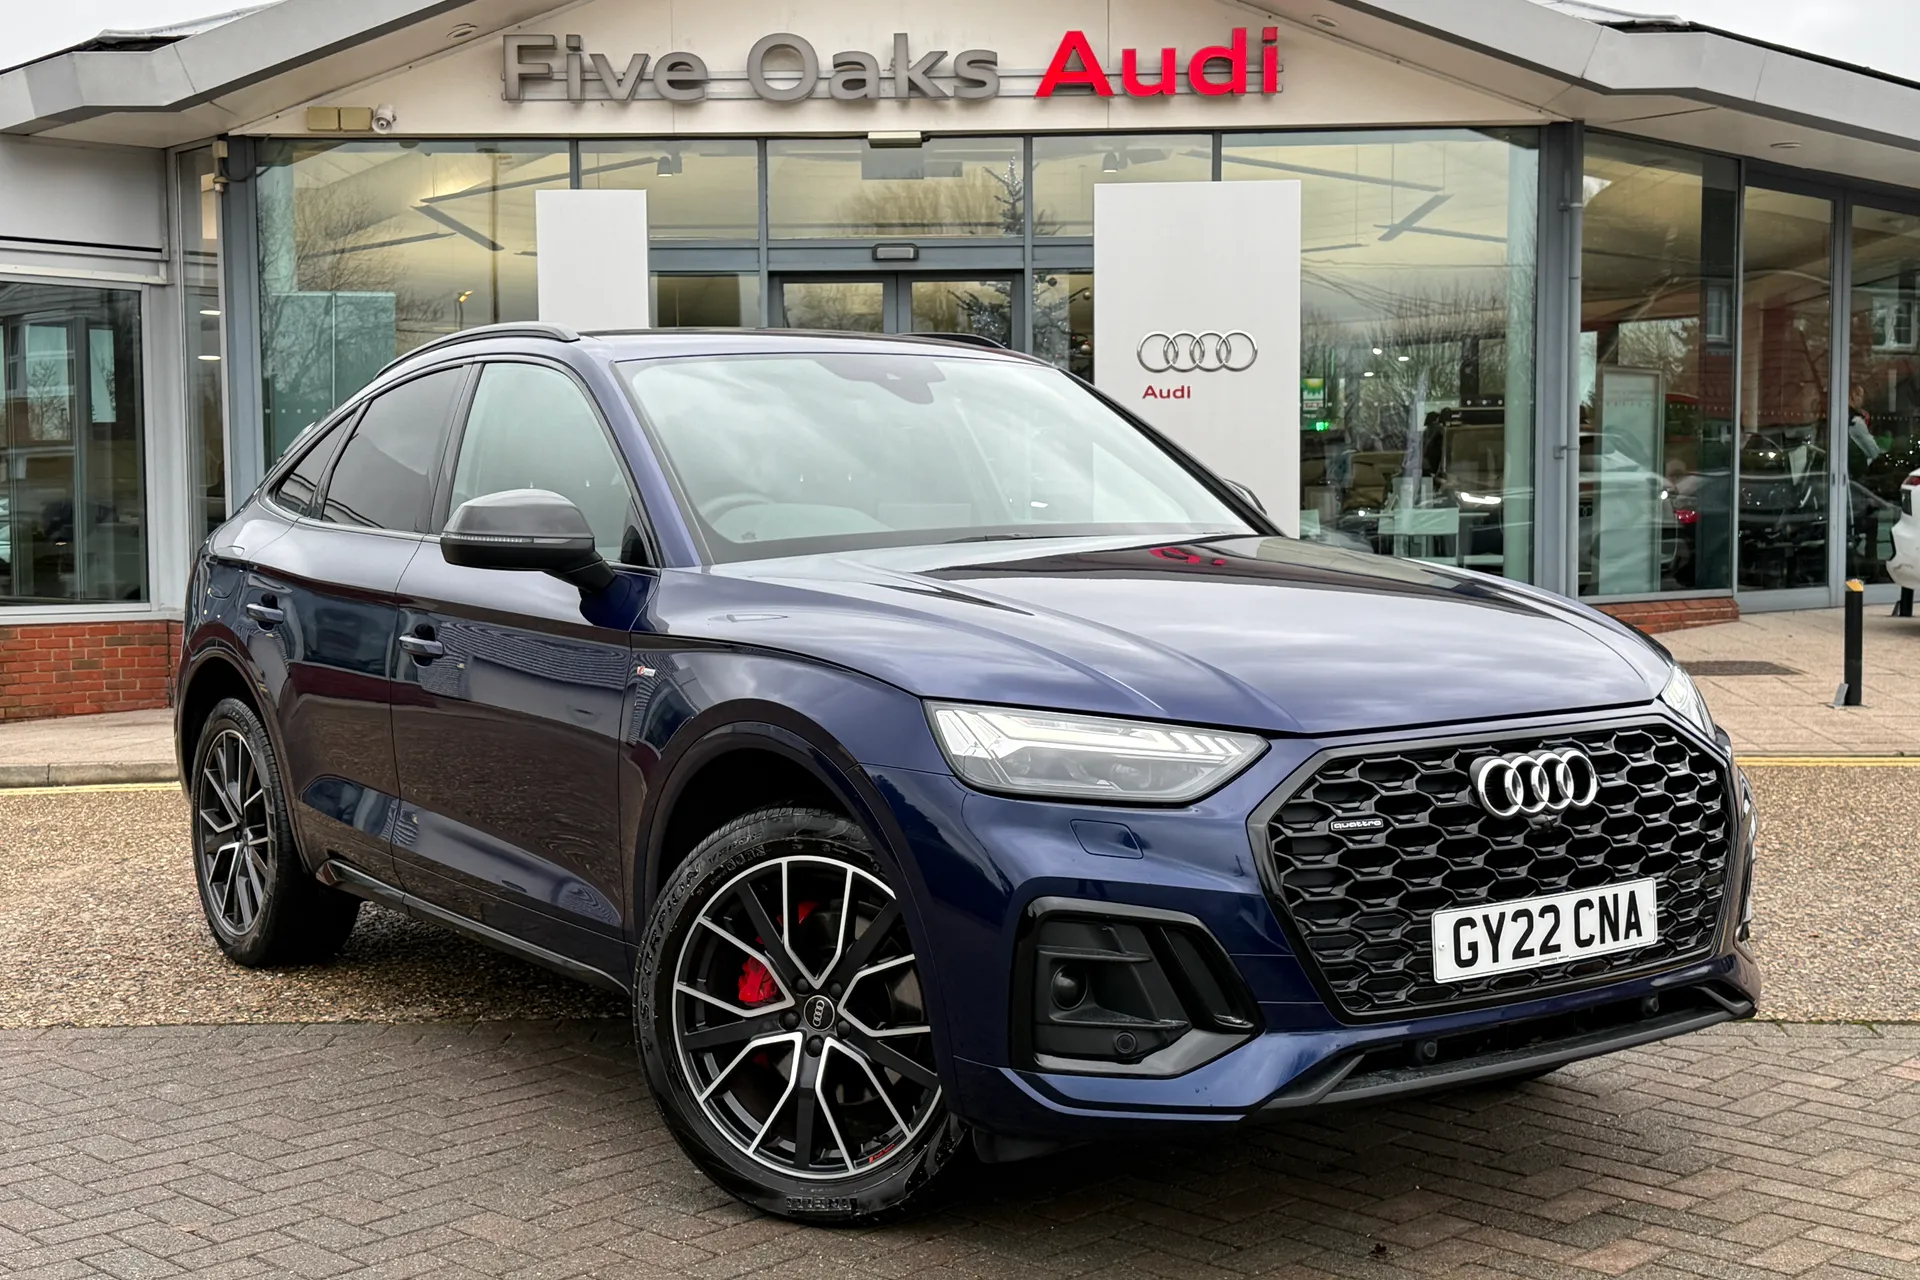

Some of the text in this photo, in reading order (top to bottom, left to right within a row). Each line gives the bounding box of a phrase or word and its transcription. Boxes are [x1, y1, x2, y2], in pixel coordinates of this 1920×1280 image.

[503, 27, 1278, 103] Five Oaks Audi
[1142, 384, 1191, 399] Audi
[1333, 820, 1382, 829] quattro
[1453, 889, 1643, 969] GY22 CNA
